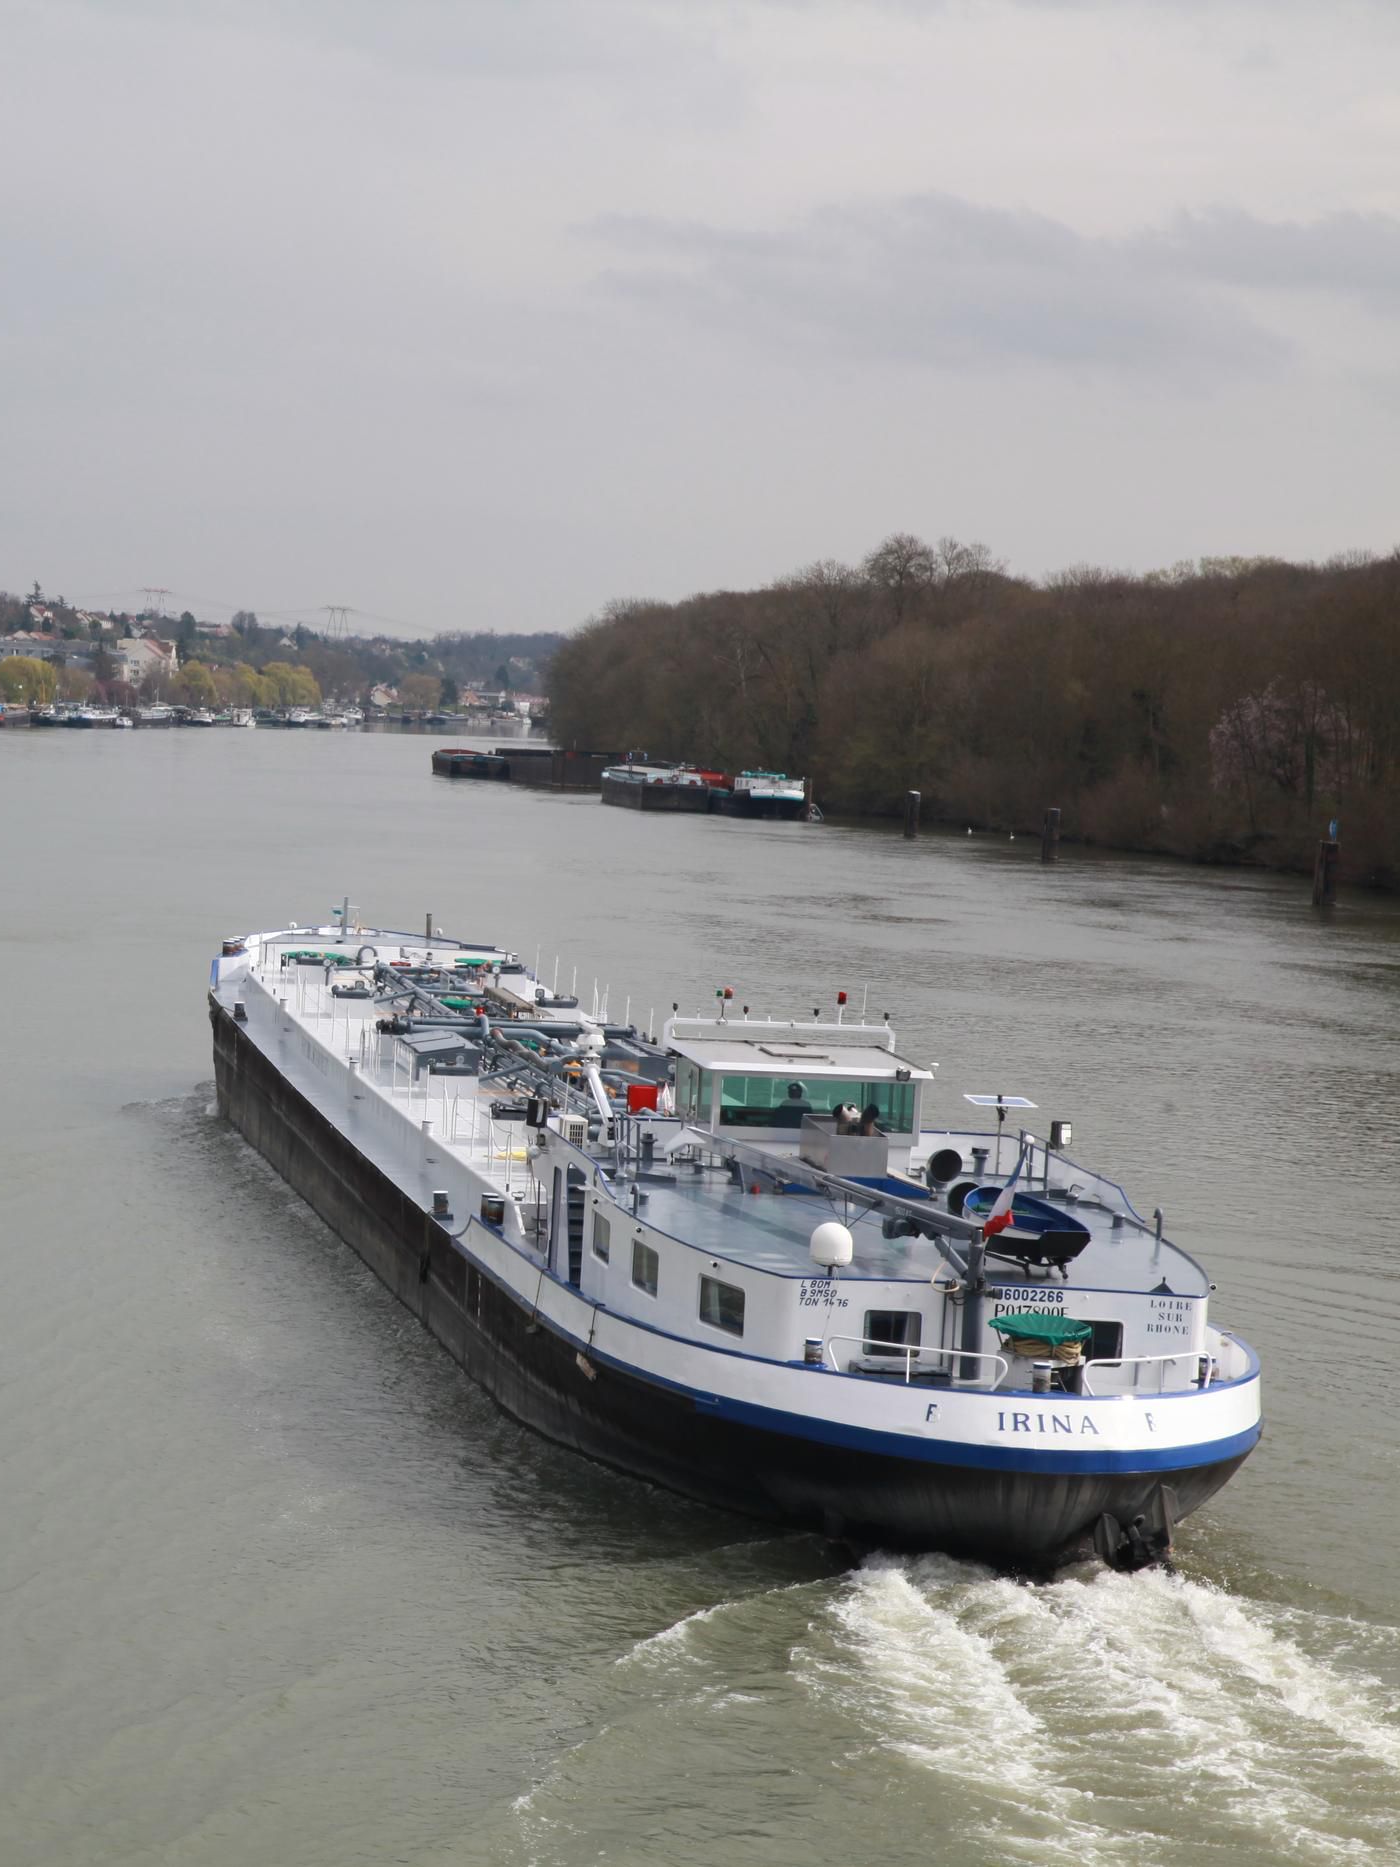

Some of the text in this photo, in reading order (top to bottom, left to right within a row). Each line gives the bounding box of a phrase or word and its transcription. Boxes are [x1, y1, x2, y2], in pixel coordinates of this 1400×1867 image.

[800, 1280, 807, 1288] L
[800, 1288, 807, 1297] B
[799, 1297, 820, 1306] TON
[1150, 1299, 1192, 1311] LOIRE
[1158, 1312, 1183, 1322] SUR
[1147, 1323, 1190, 1335] RHONE
[997, 1411, 1099, 1434] IRINA
